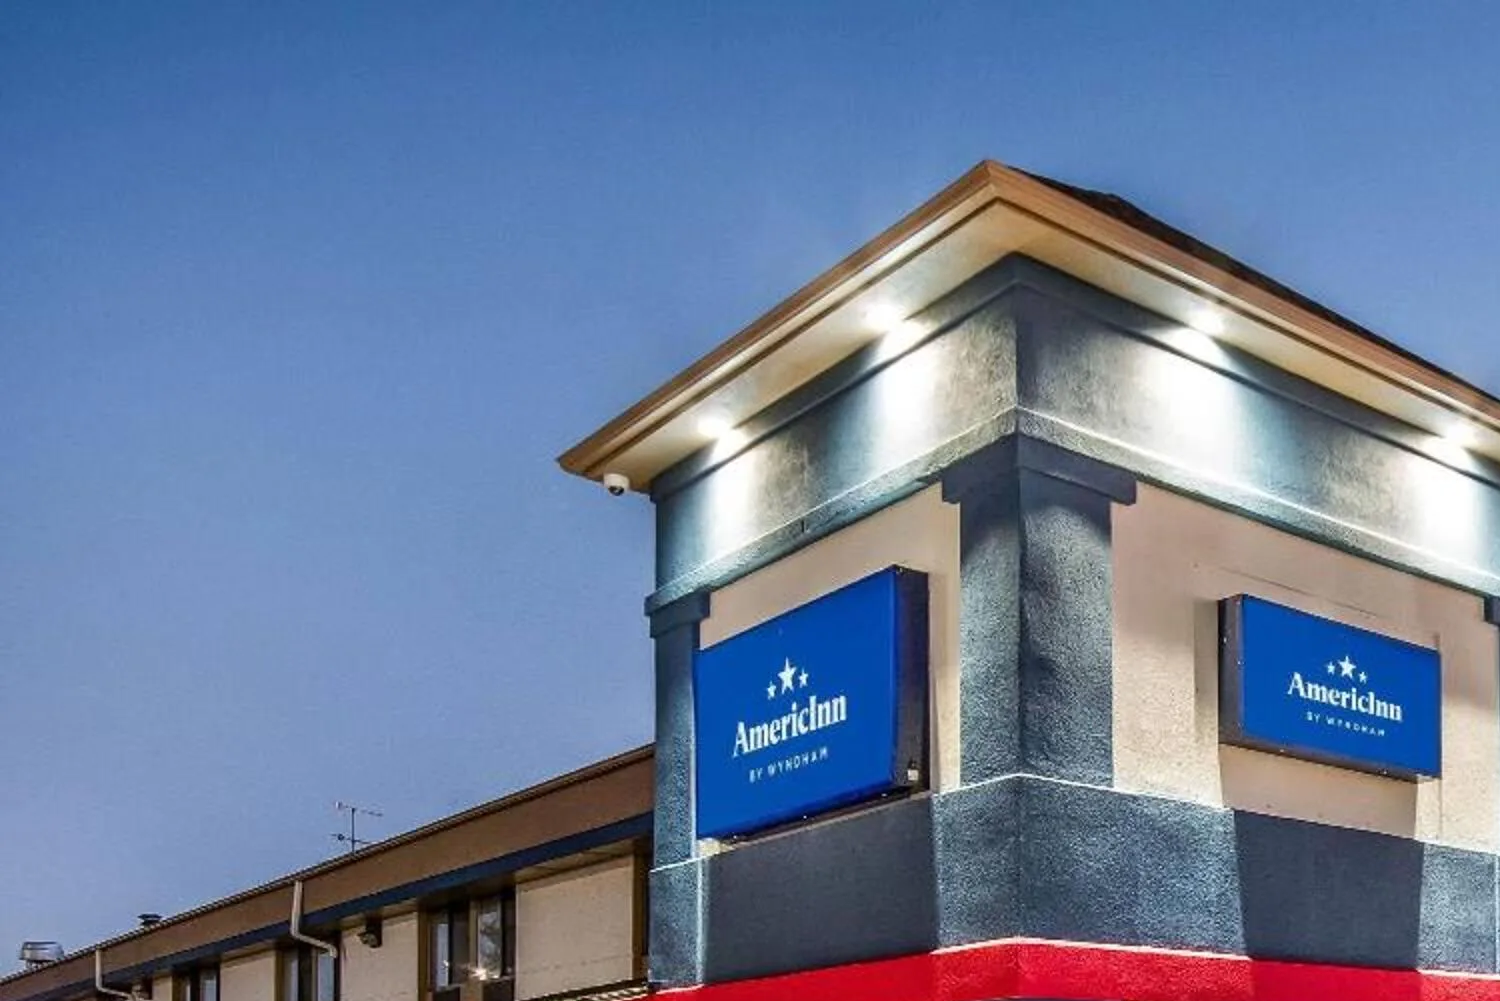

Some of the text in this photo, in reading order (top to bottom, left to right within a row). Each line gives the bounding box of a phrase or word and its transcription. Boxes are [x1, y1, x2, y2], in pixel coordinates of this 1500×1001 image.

[1287, 671, 1403, 723] AmericInn
[732, 695, 848, 757] AmericInn
[1306, 711, 1385, 736] BY WYNDHAM
[749, 747, 829, 783] BY WYNDHAM
